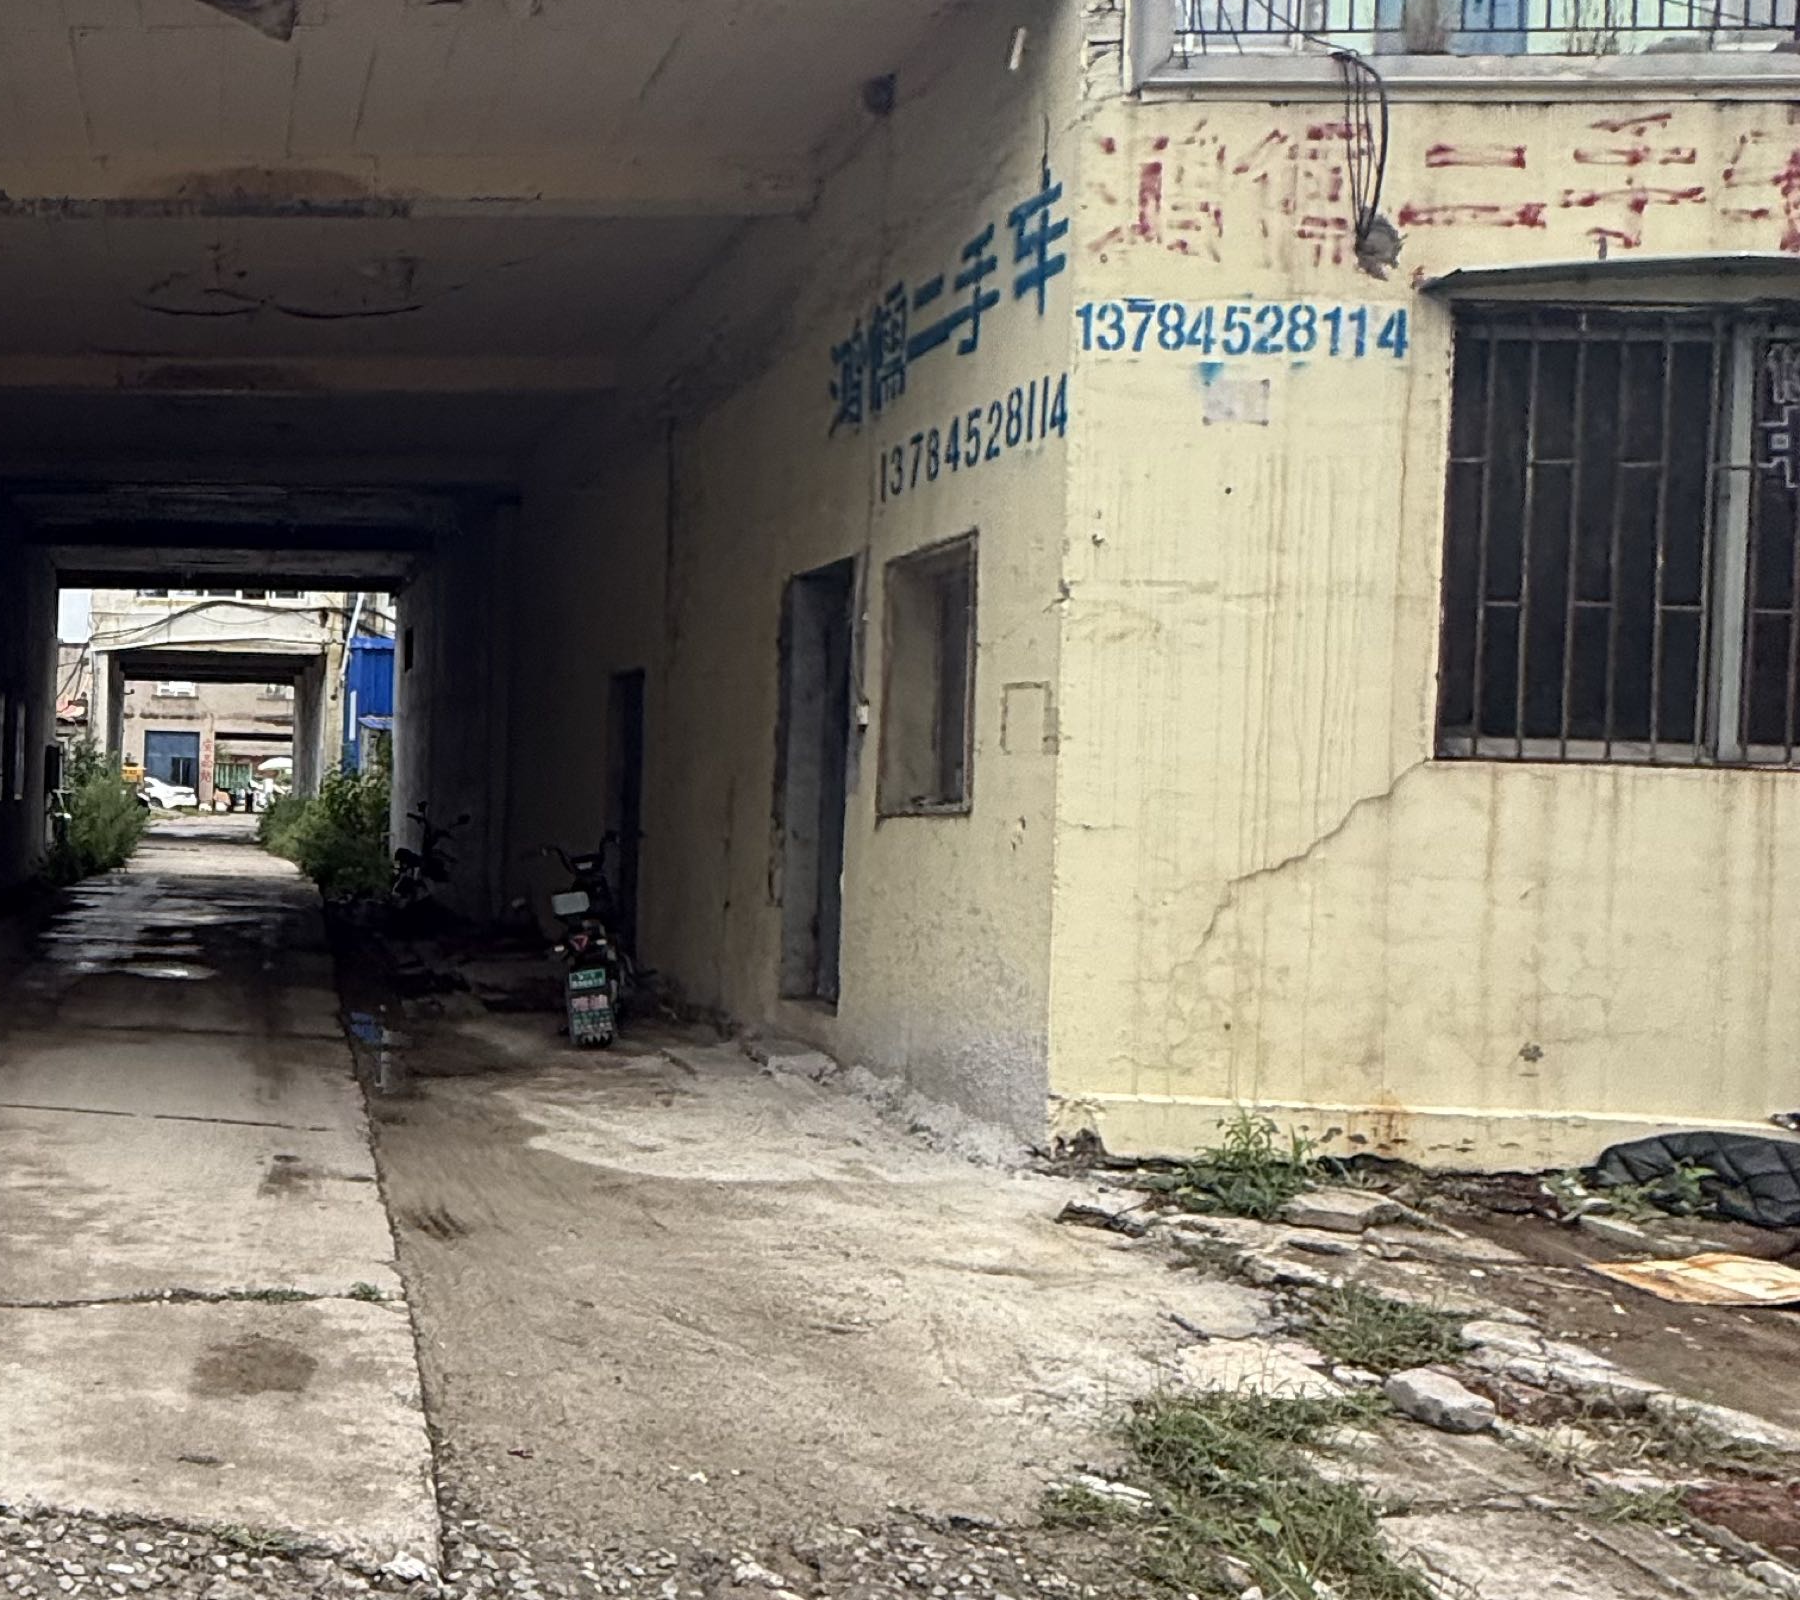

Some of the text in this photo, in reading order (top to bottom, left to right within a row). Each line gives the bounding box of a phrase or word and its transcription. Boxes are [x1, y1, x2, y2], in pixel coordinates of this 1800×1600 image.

[828, 167, 1070, 439] 鸿儒二手车
[1075, 299, 1408, 358] 13784528114
[880, 372, 1070, 504] 13784528114
